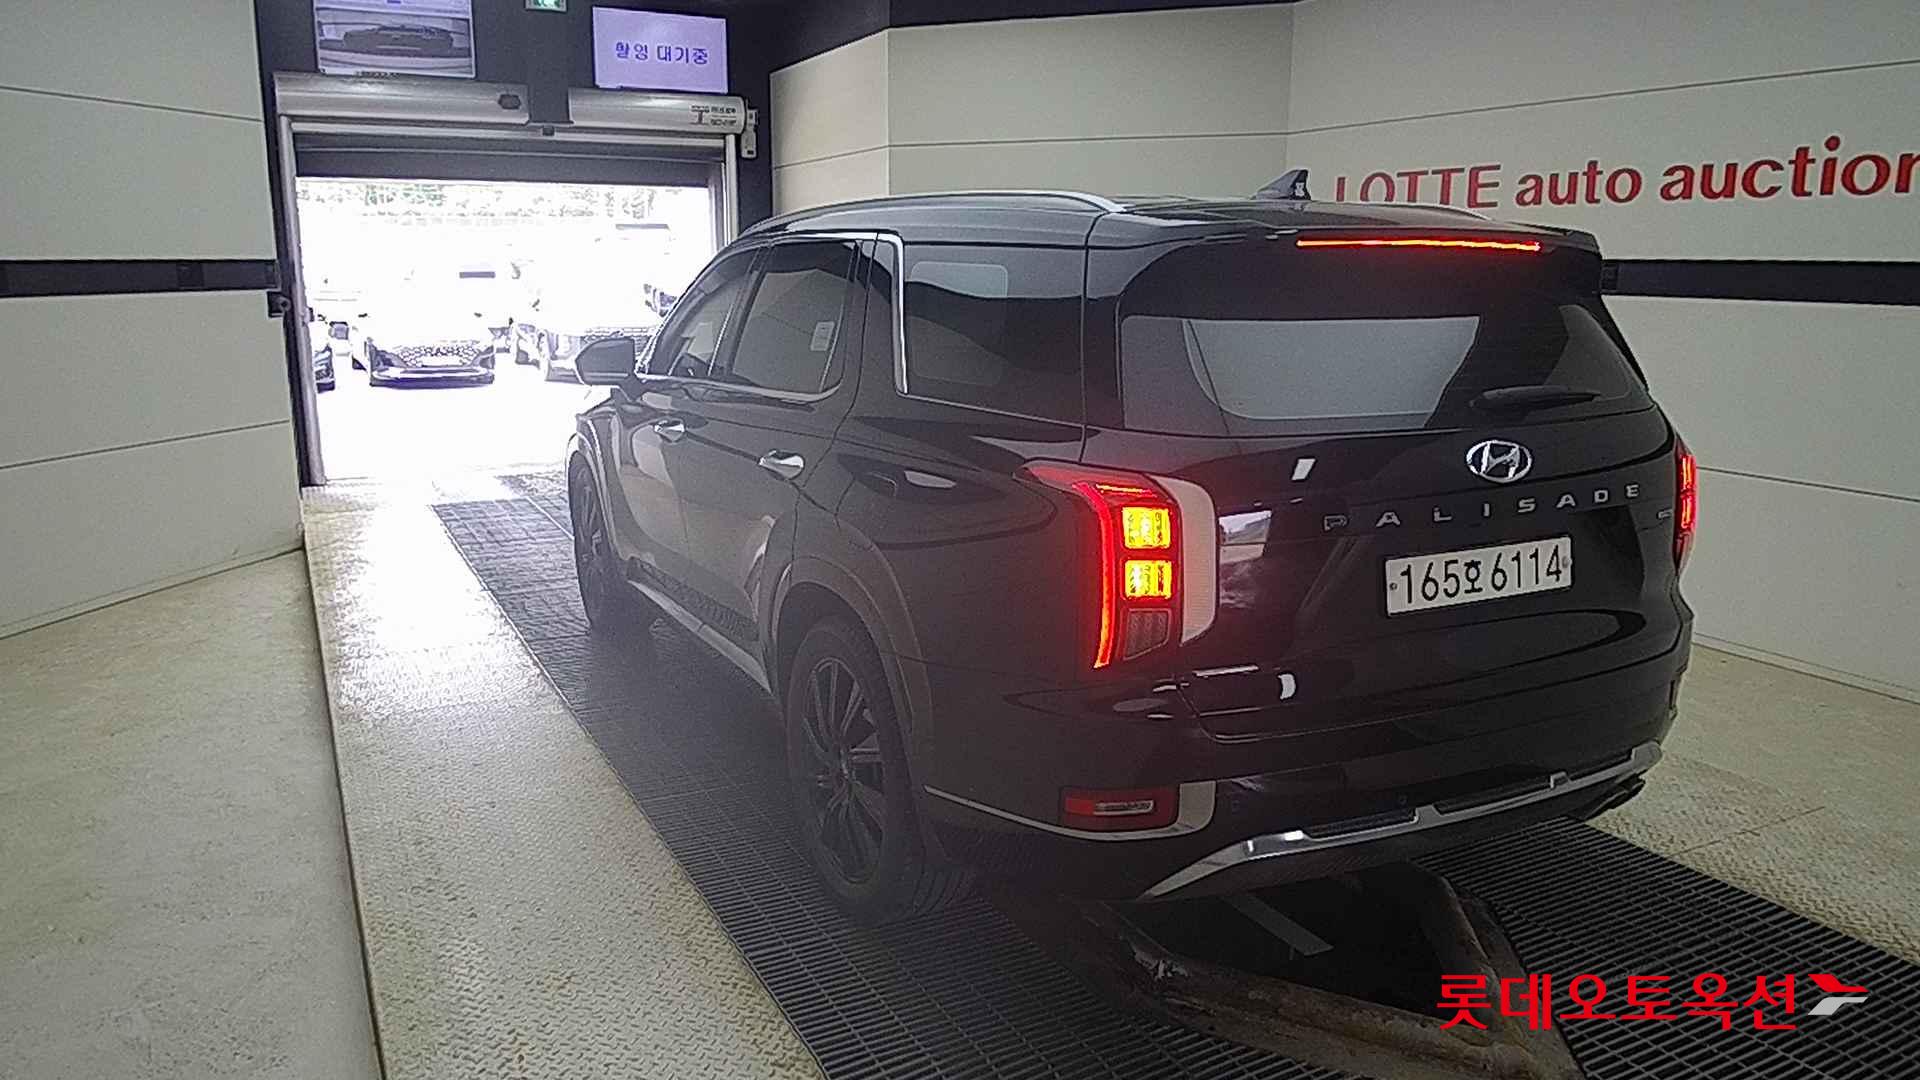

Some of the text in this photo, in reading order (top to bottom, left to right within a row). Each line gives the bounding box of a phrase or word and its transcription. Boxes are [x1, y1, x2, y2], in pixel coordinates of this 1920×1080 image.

[657, 45, 708, 65] 대기중
[1515, 160, 1642, 206] auto
[1323, 484, 1640, 532] PALISADE
